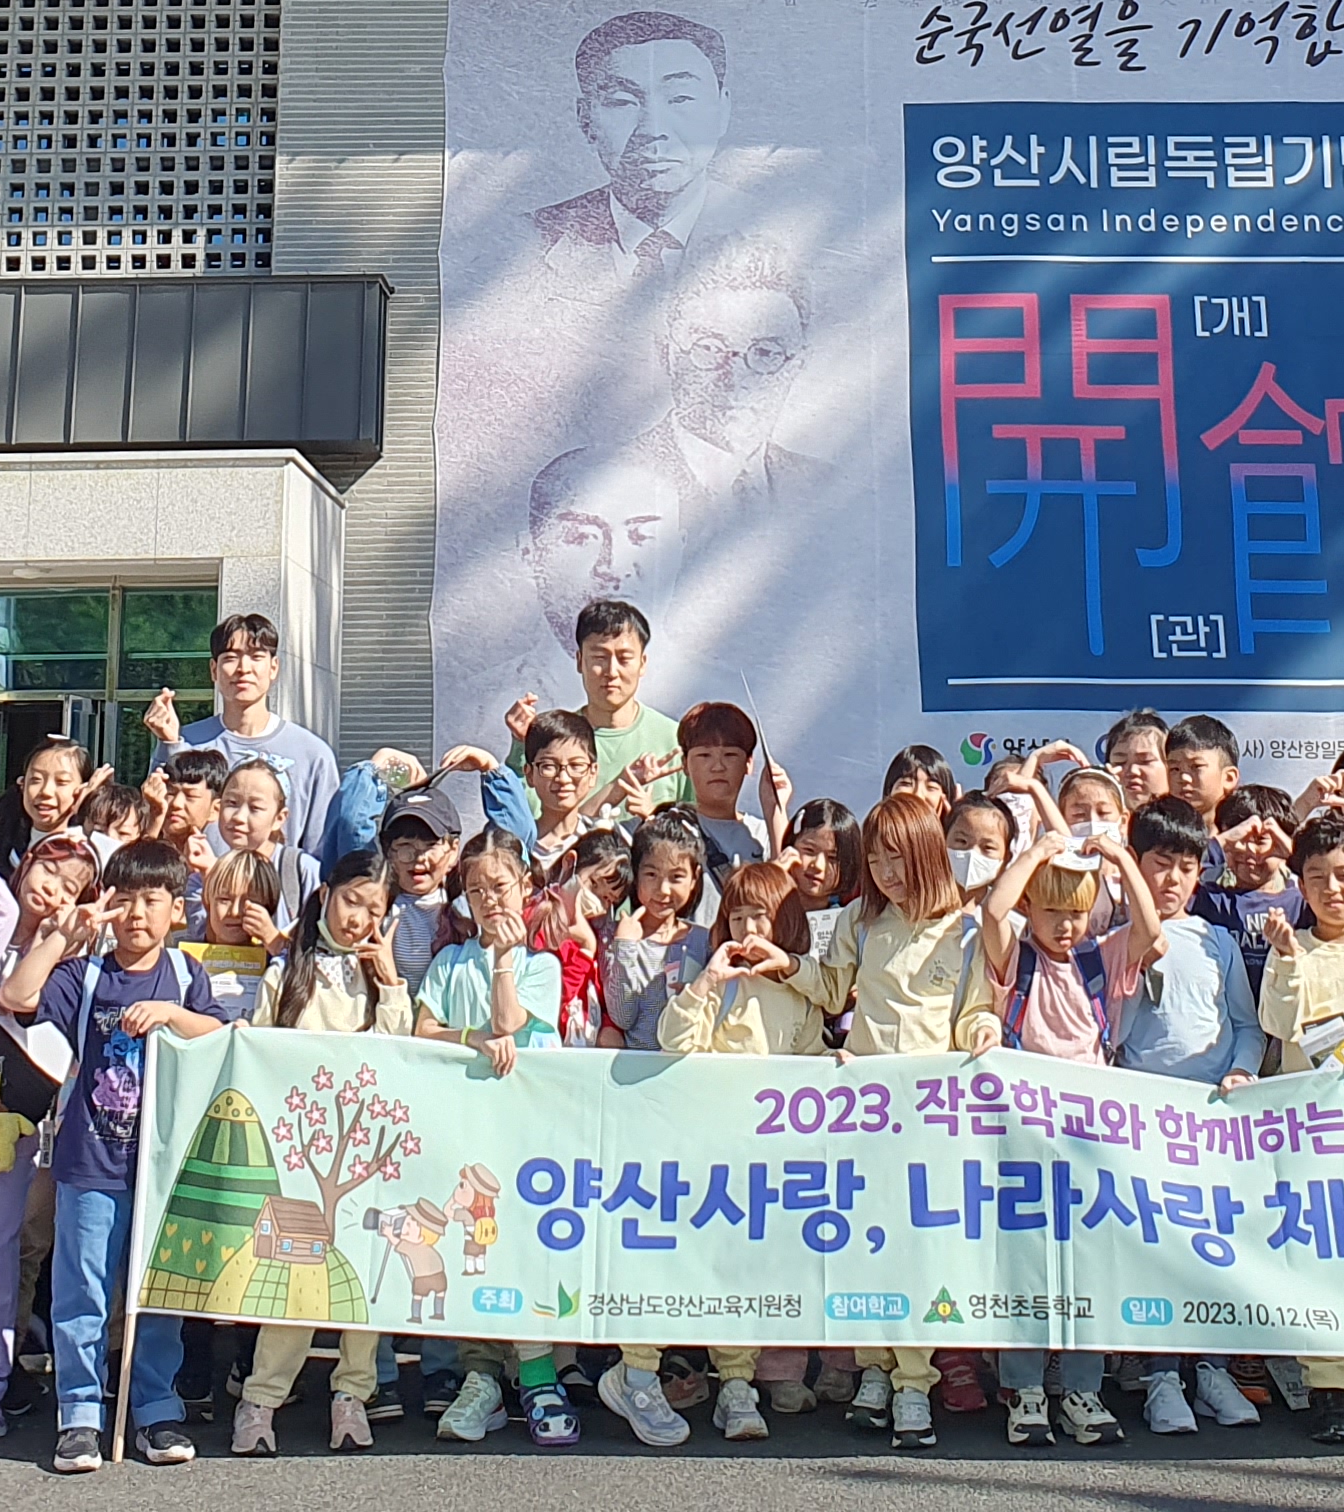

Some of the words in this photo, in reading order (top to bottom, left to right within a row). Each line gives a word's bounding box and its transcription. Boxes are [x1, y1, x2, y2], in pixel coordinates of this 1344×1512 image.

[931, 208, 1089, 237] Yangsan
[1192, 295, 1268, 337] [개]
[1149, 614, 1227, 658] [관]
[754, 1083, 902, 1136] 2023.
[914, 1071, 1146, 1152] 작은학교와
[514, 1155, 886, 1254] 양산사랑,
[907, 1158, 1244, 1268] 나라사랑
[478, 1291, 517, 1311] 주최
[586, 1292, 803, 1319] 경상남도양산교육지원청
[830, 1294, 905, 1319] 참여학교
[967, 1293, 1096, 1321] 영천초등학교
[1128, 1298, 1167, 1322] 일시
[1182, 1300, 1340, 1332] 2023.10.12.(목)
